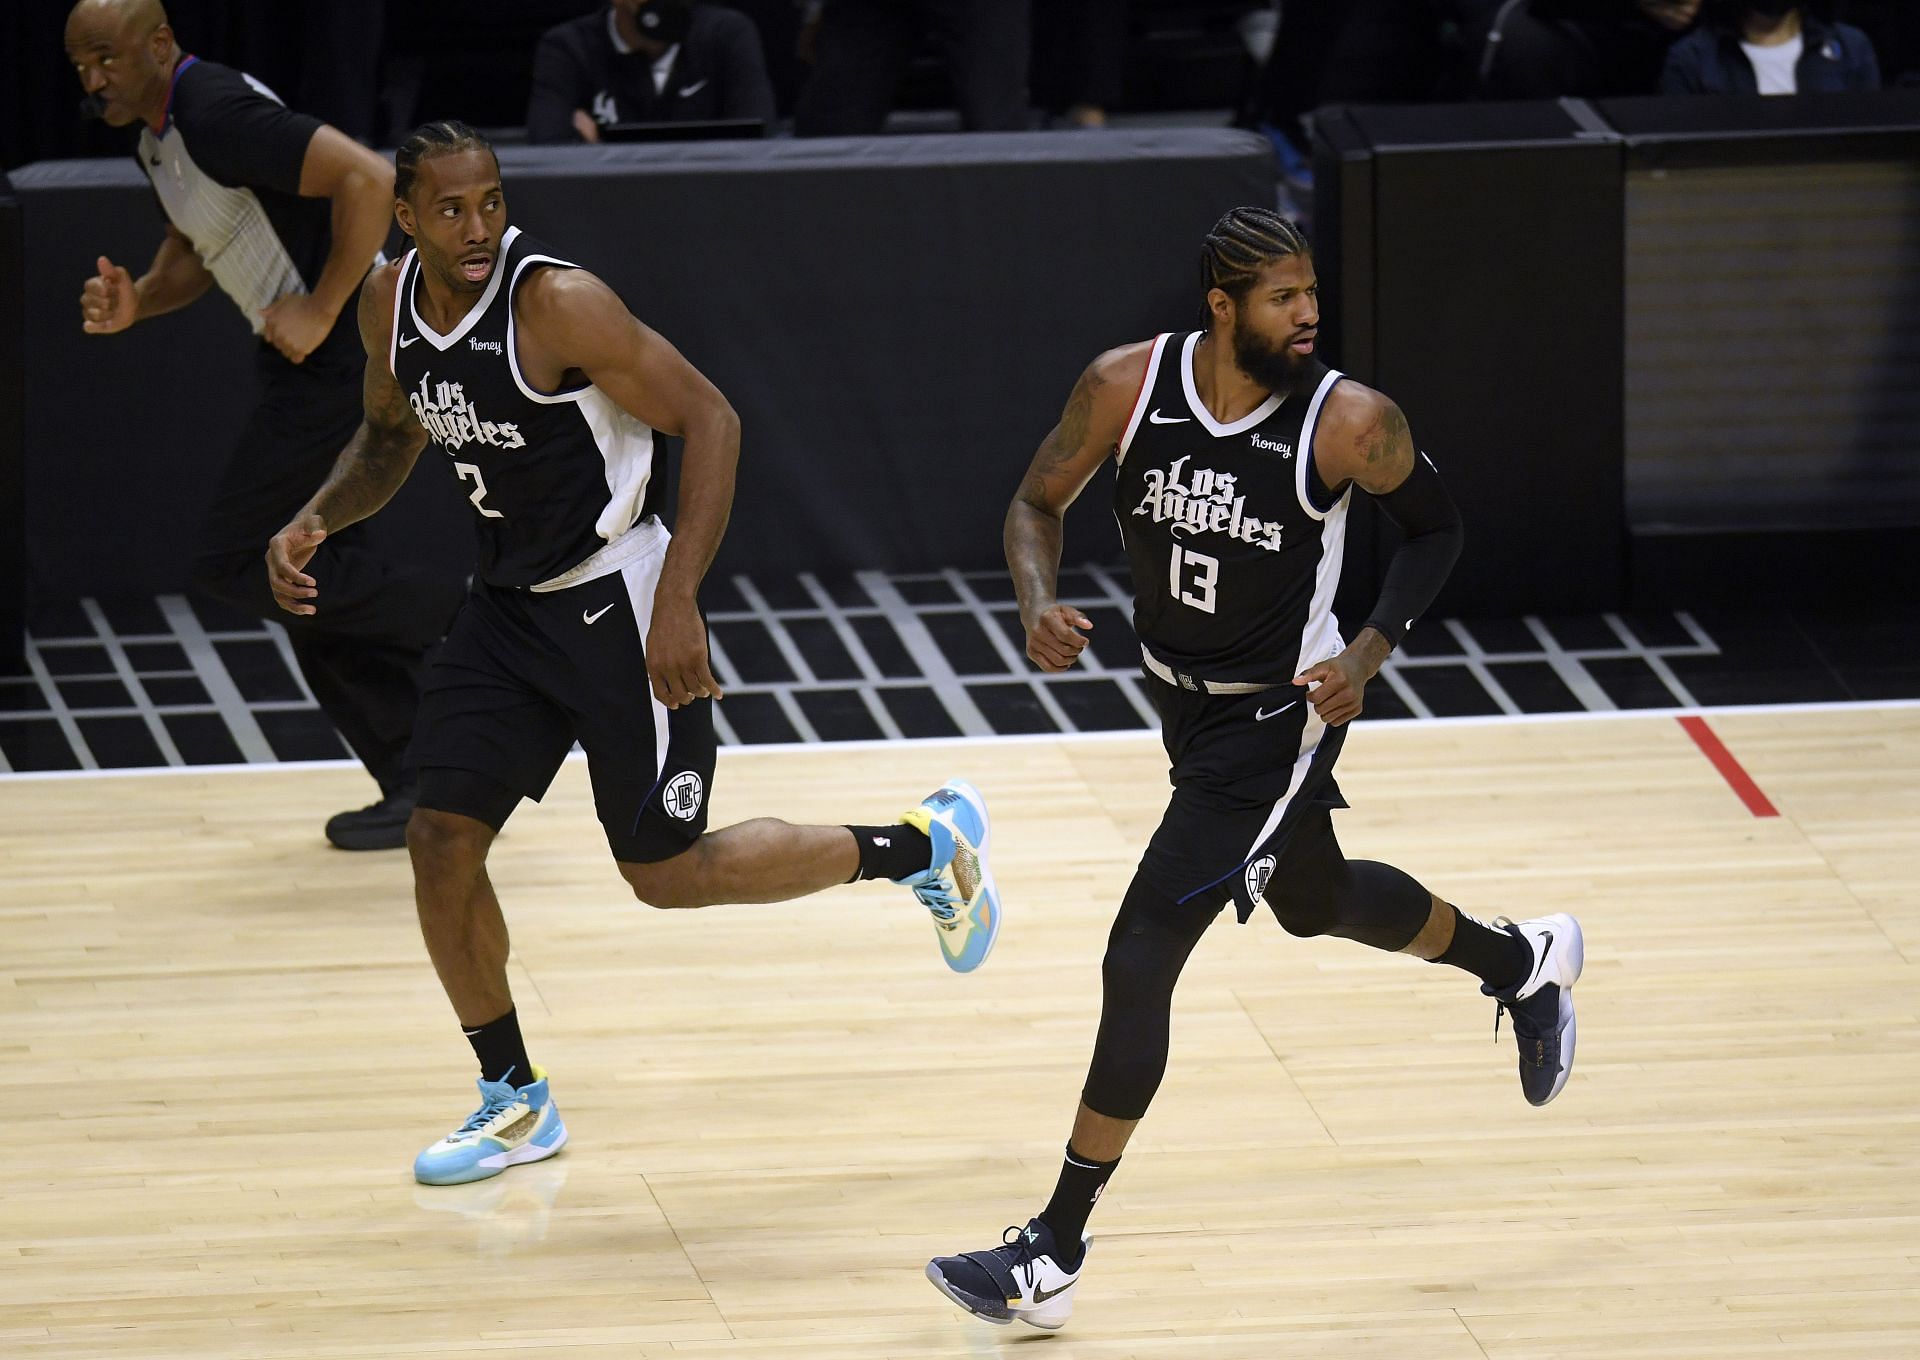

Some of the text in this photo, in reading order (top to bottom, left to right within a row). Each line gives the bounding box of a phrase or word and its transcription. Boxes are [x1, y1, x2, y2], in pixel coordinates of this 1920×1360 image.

[468, 336, 502, 355] honey
[419, 371, 467, 415] Los
[409, 391, 527, 456] Angeles
[1250, 433, 1292, 459] honey
[453, 461, 505, 518] 2
[1164, 455, 1238, 505] Los
[1132, 468, 1284, 552] Angeles
[1169, 542, 1219, 614] 13
